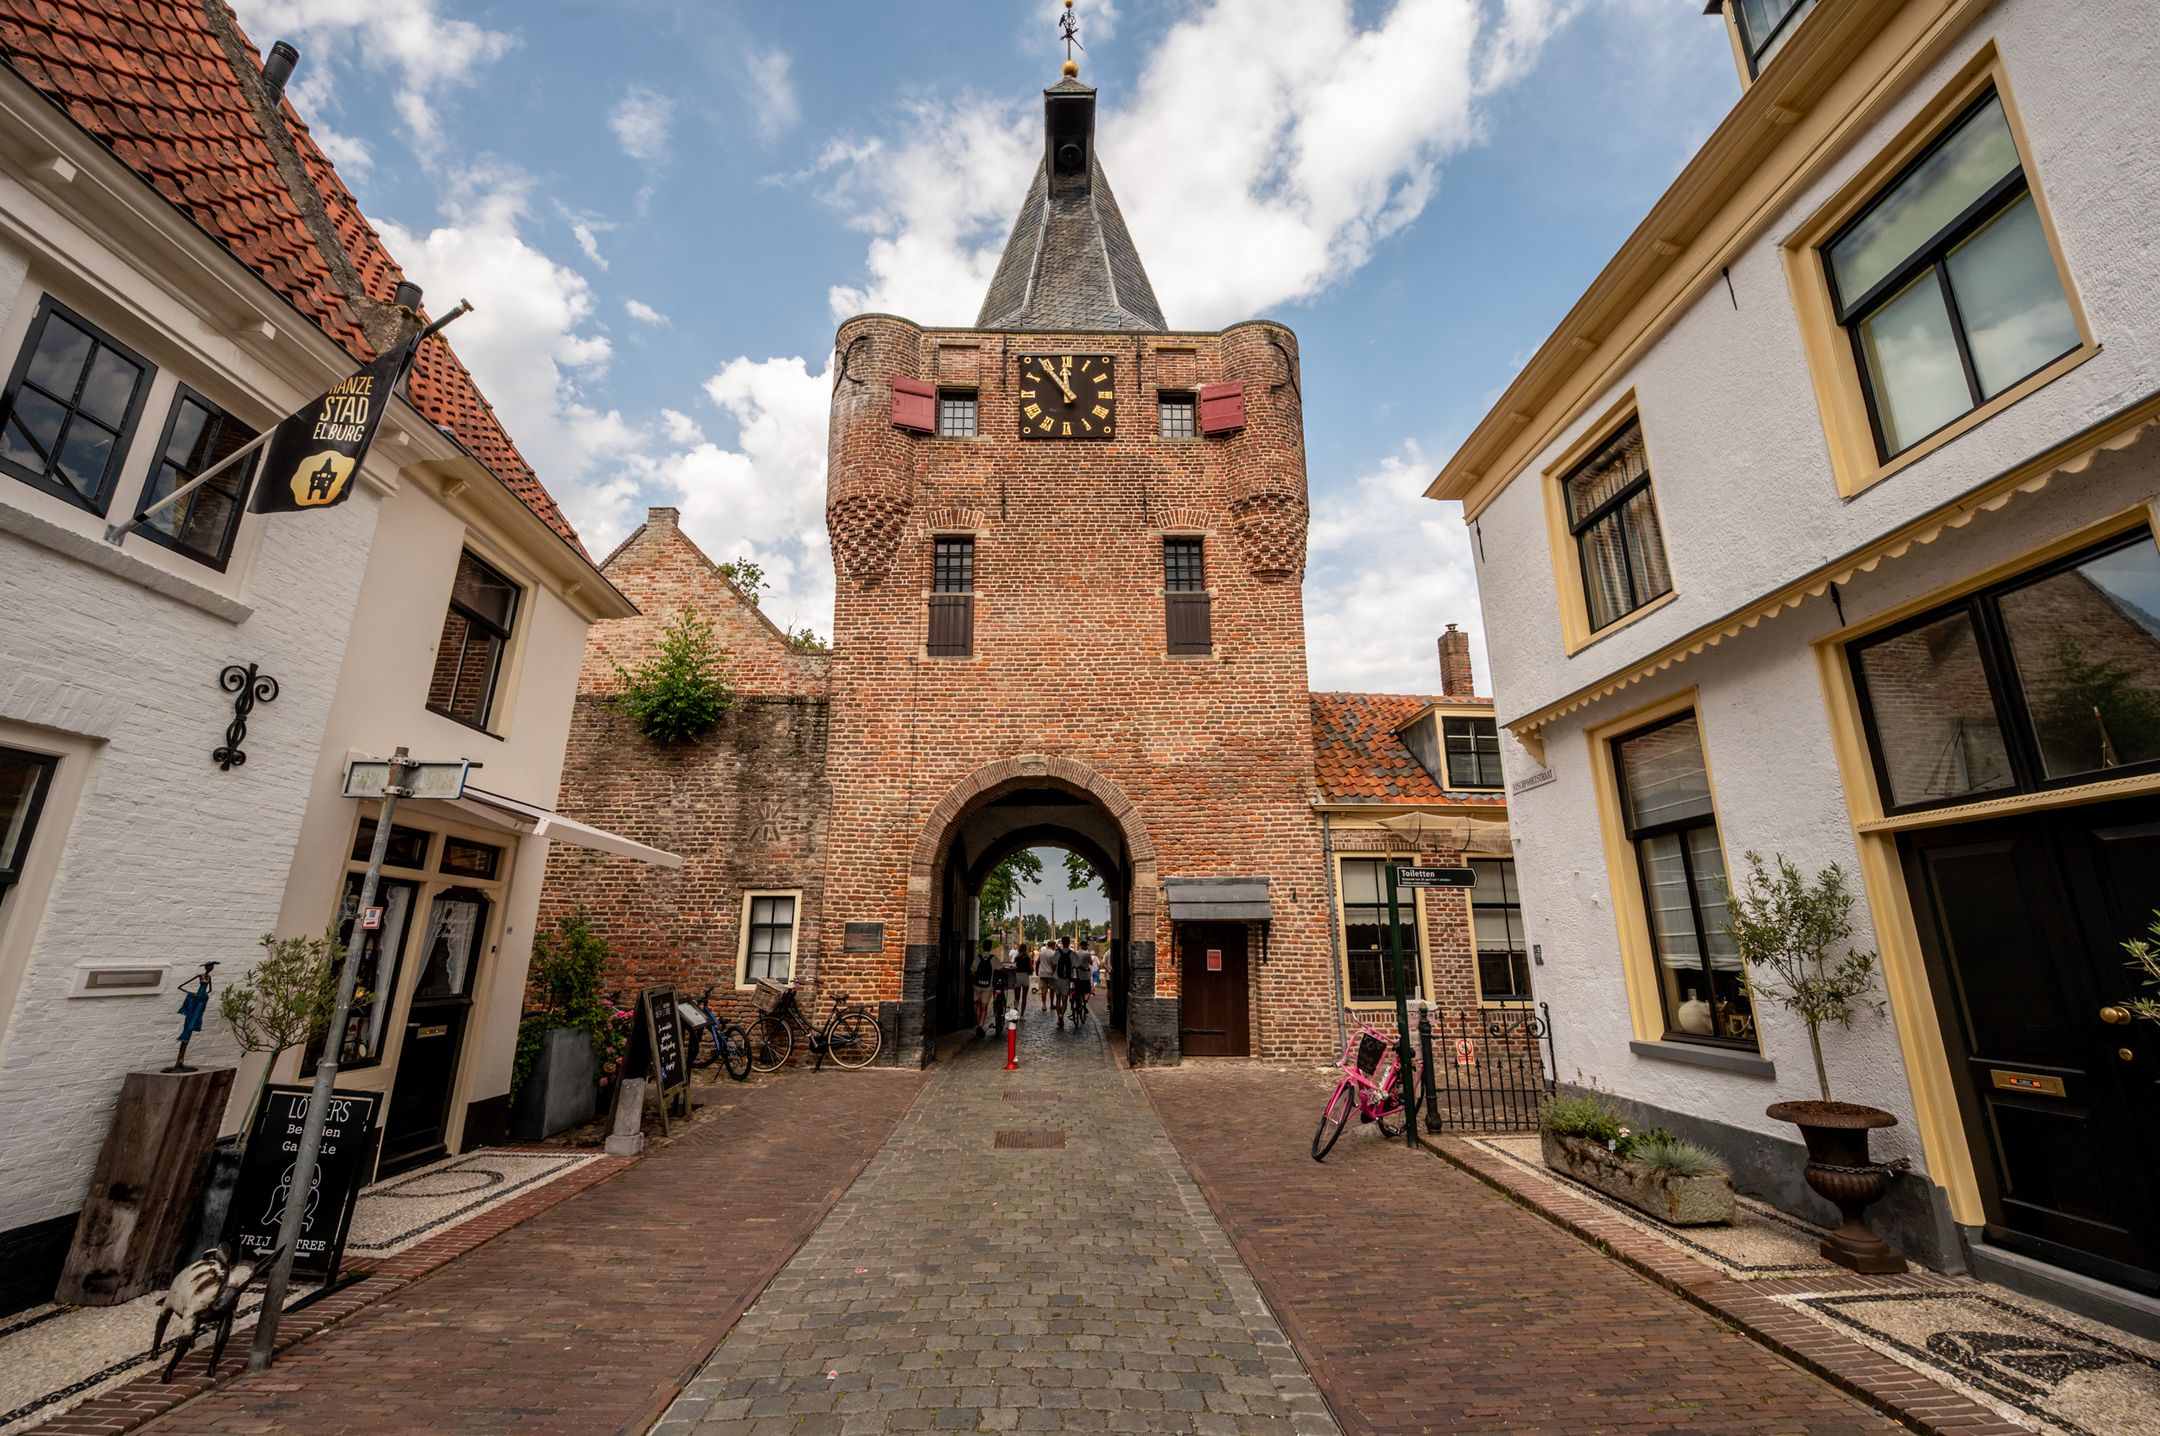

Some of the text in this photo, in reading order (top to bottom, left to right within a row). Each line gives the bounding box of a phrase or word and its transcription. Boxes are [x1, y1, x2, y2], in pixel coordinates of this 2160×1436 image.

[320, 396, 369, 424] STAD
[312, 422, 365, 442] ELBURG
[1401, 869, 1435, 877] Toiletten
[288, 1095, 352, 1123] LÖERS
[286, 1124, 341, 1138] Been
[282, 1141, 337, 1155] Gaie
